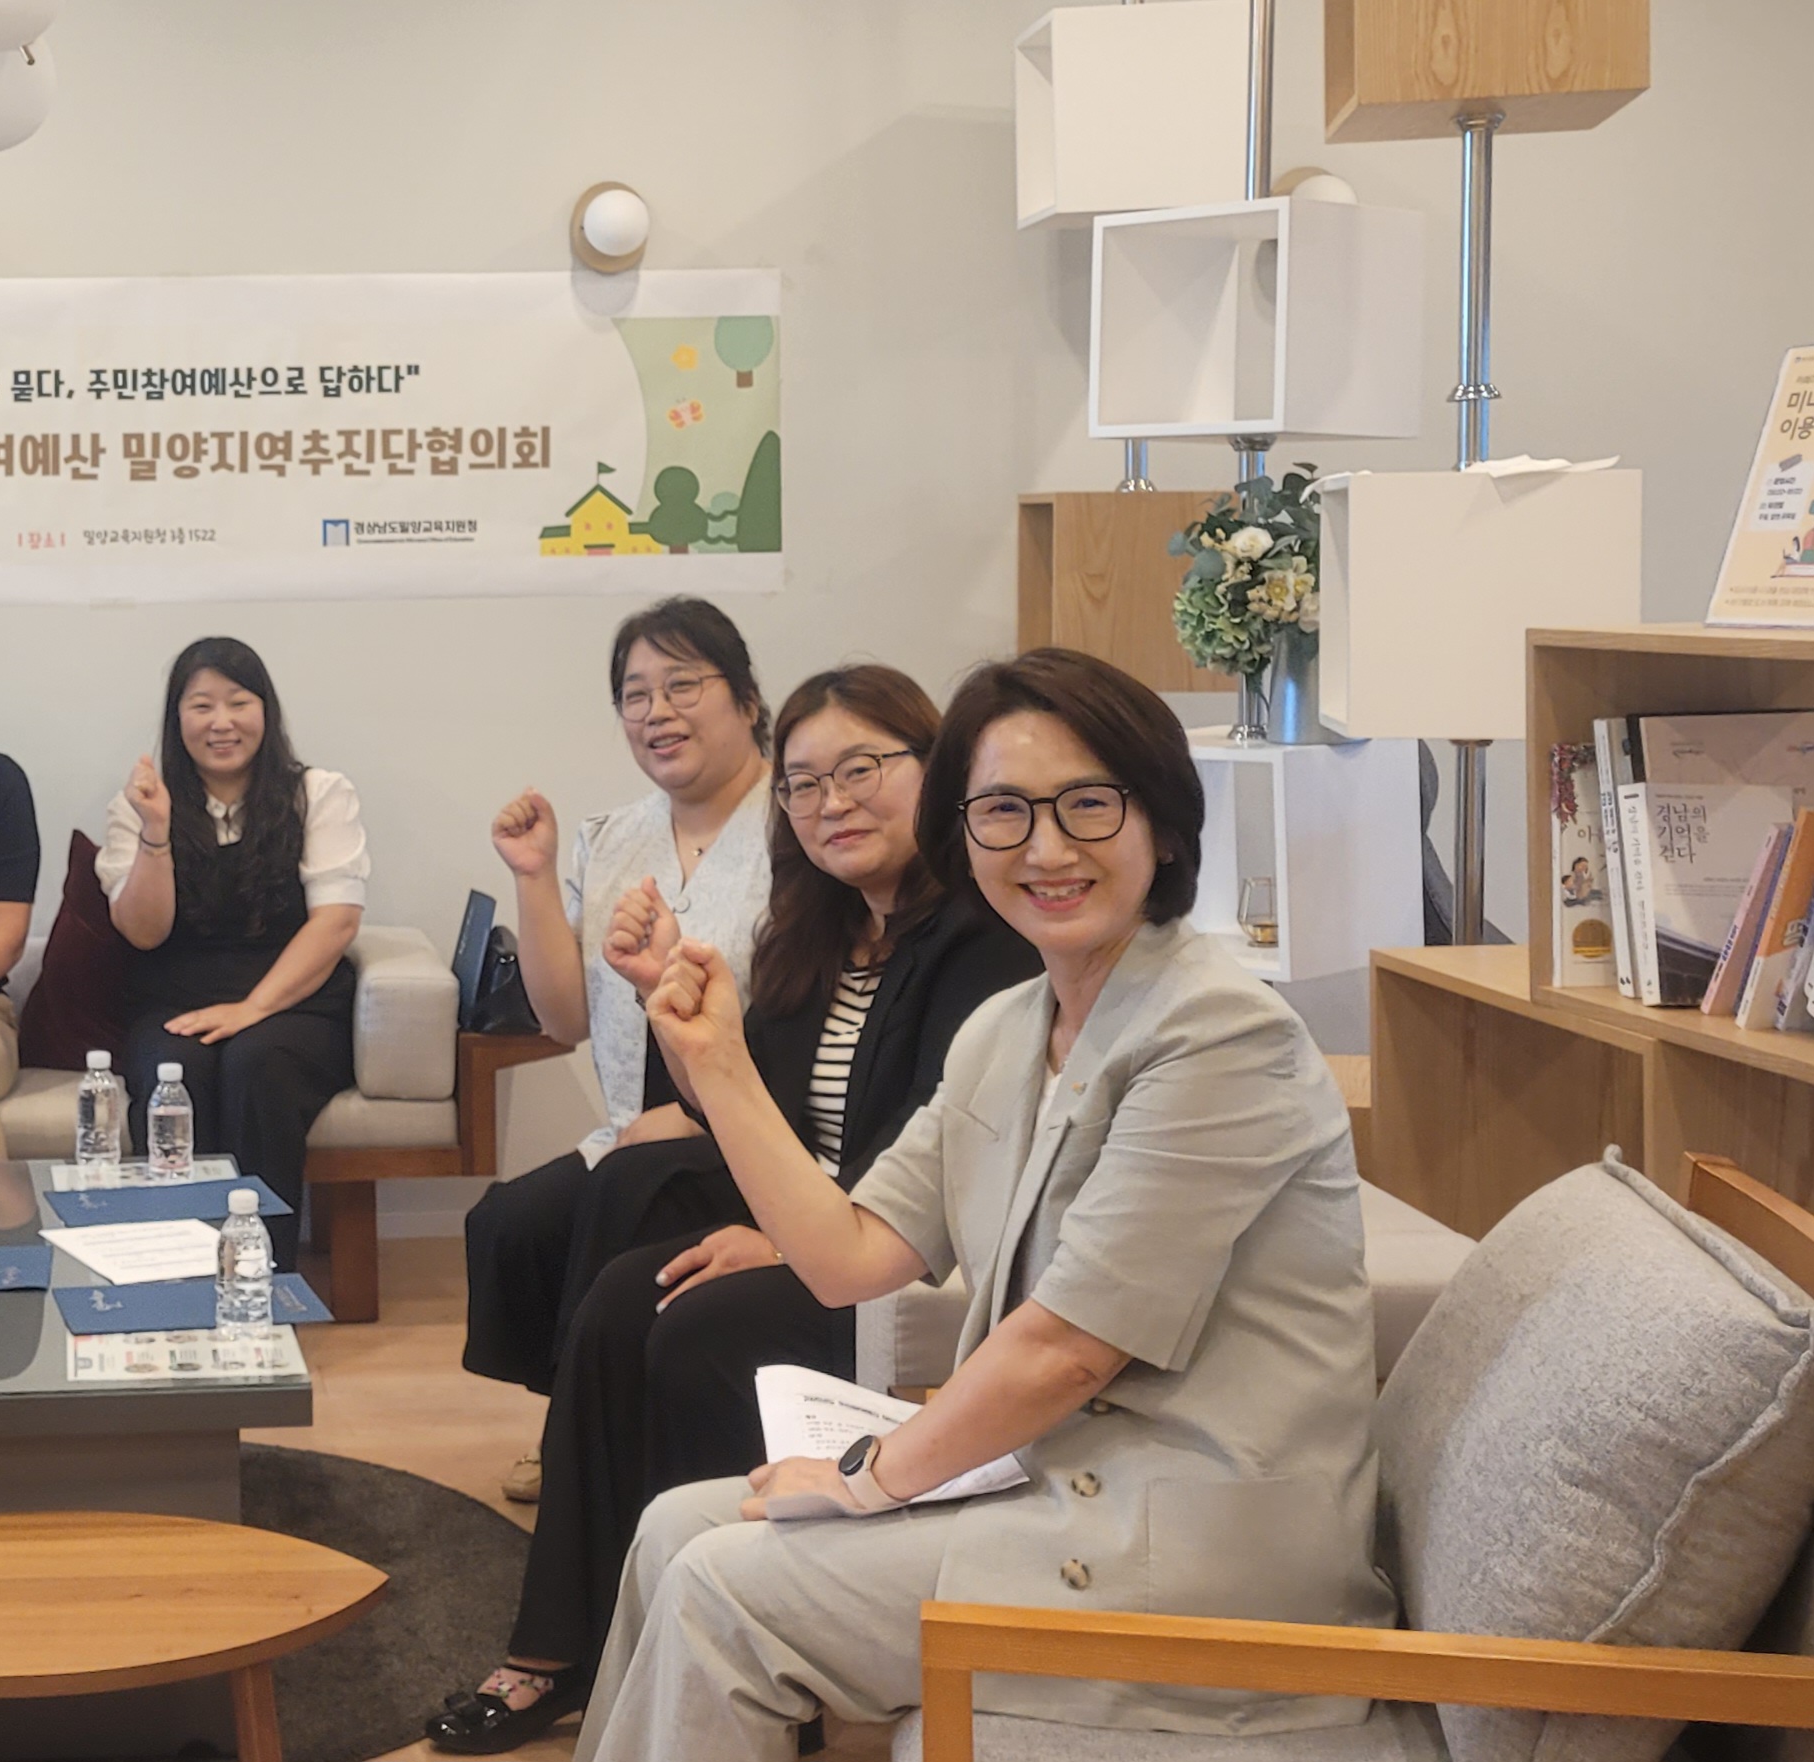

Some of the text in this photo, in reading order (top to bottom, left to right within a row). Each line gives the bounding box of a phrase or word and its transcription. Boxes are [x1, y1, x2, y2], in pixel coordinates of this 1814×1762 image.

[10, 369, 75, 403] 묻다,
[86, 366, 308, 401] 주민참여예산으로
[318, 364, 420, 398] 답하다"
[122, 425, 551, 482] 밀양지역추진단협의회
[83, 528, 167, 546] 밀양교육지원청
